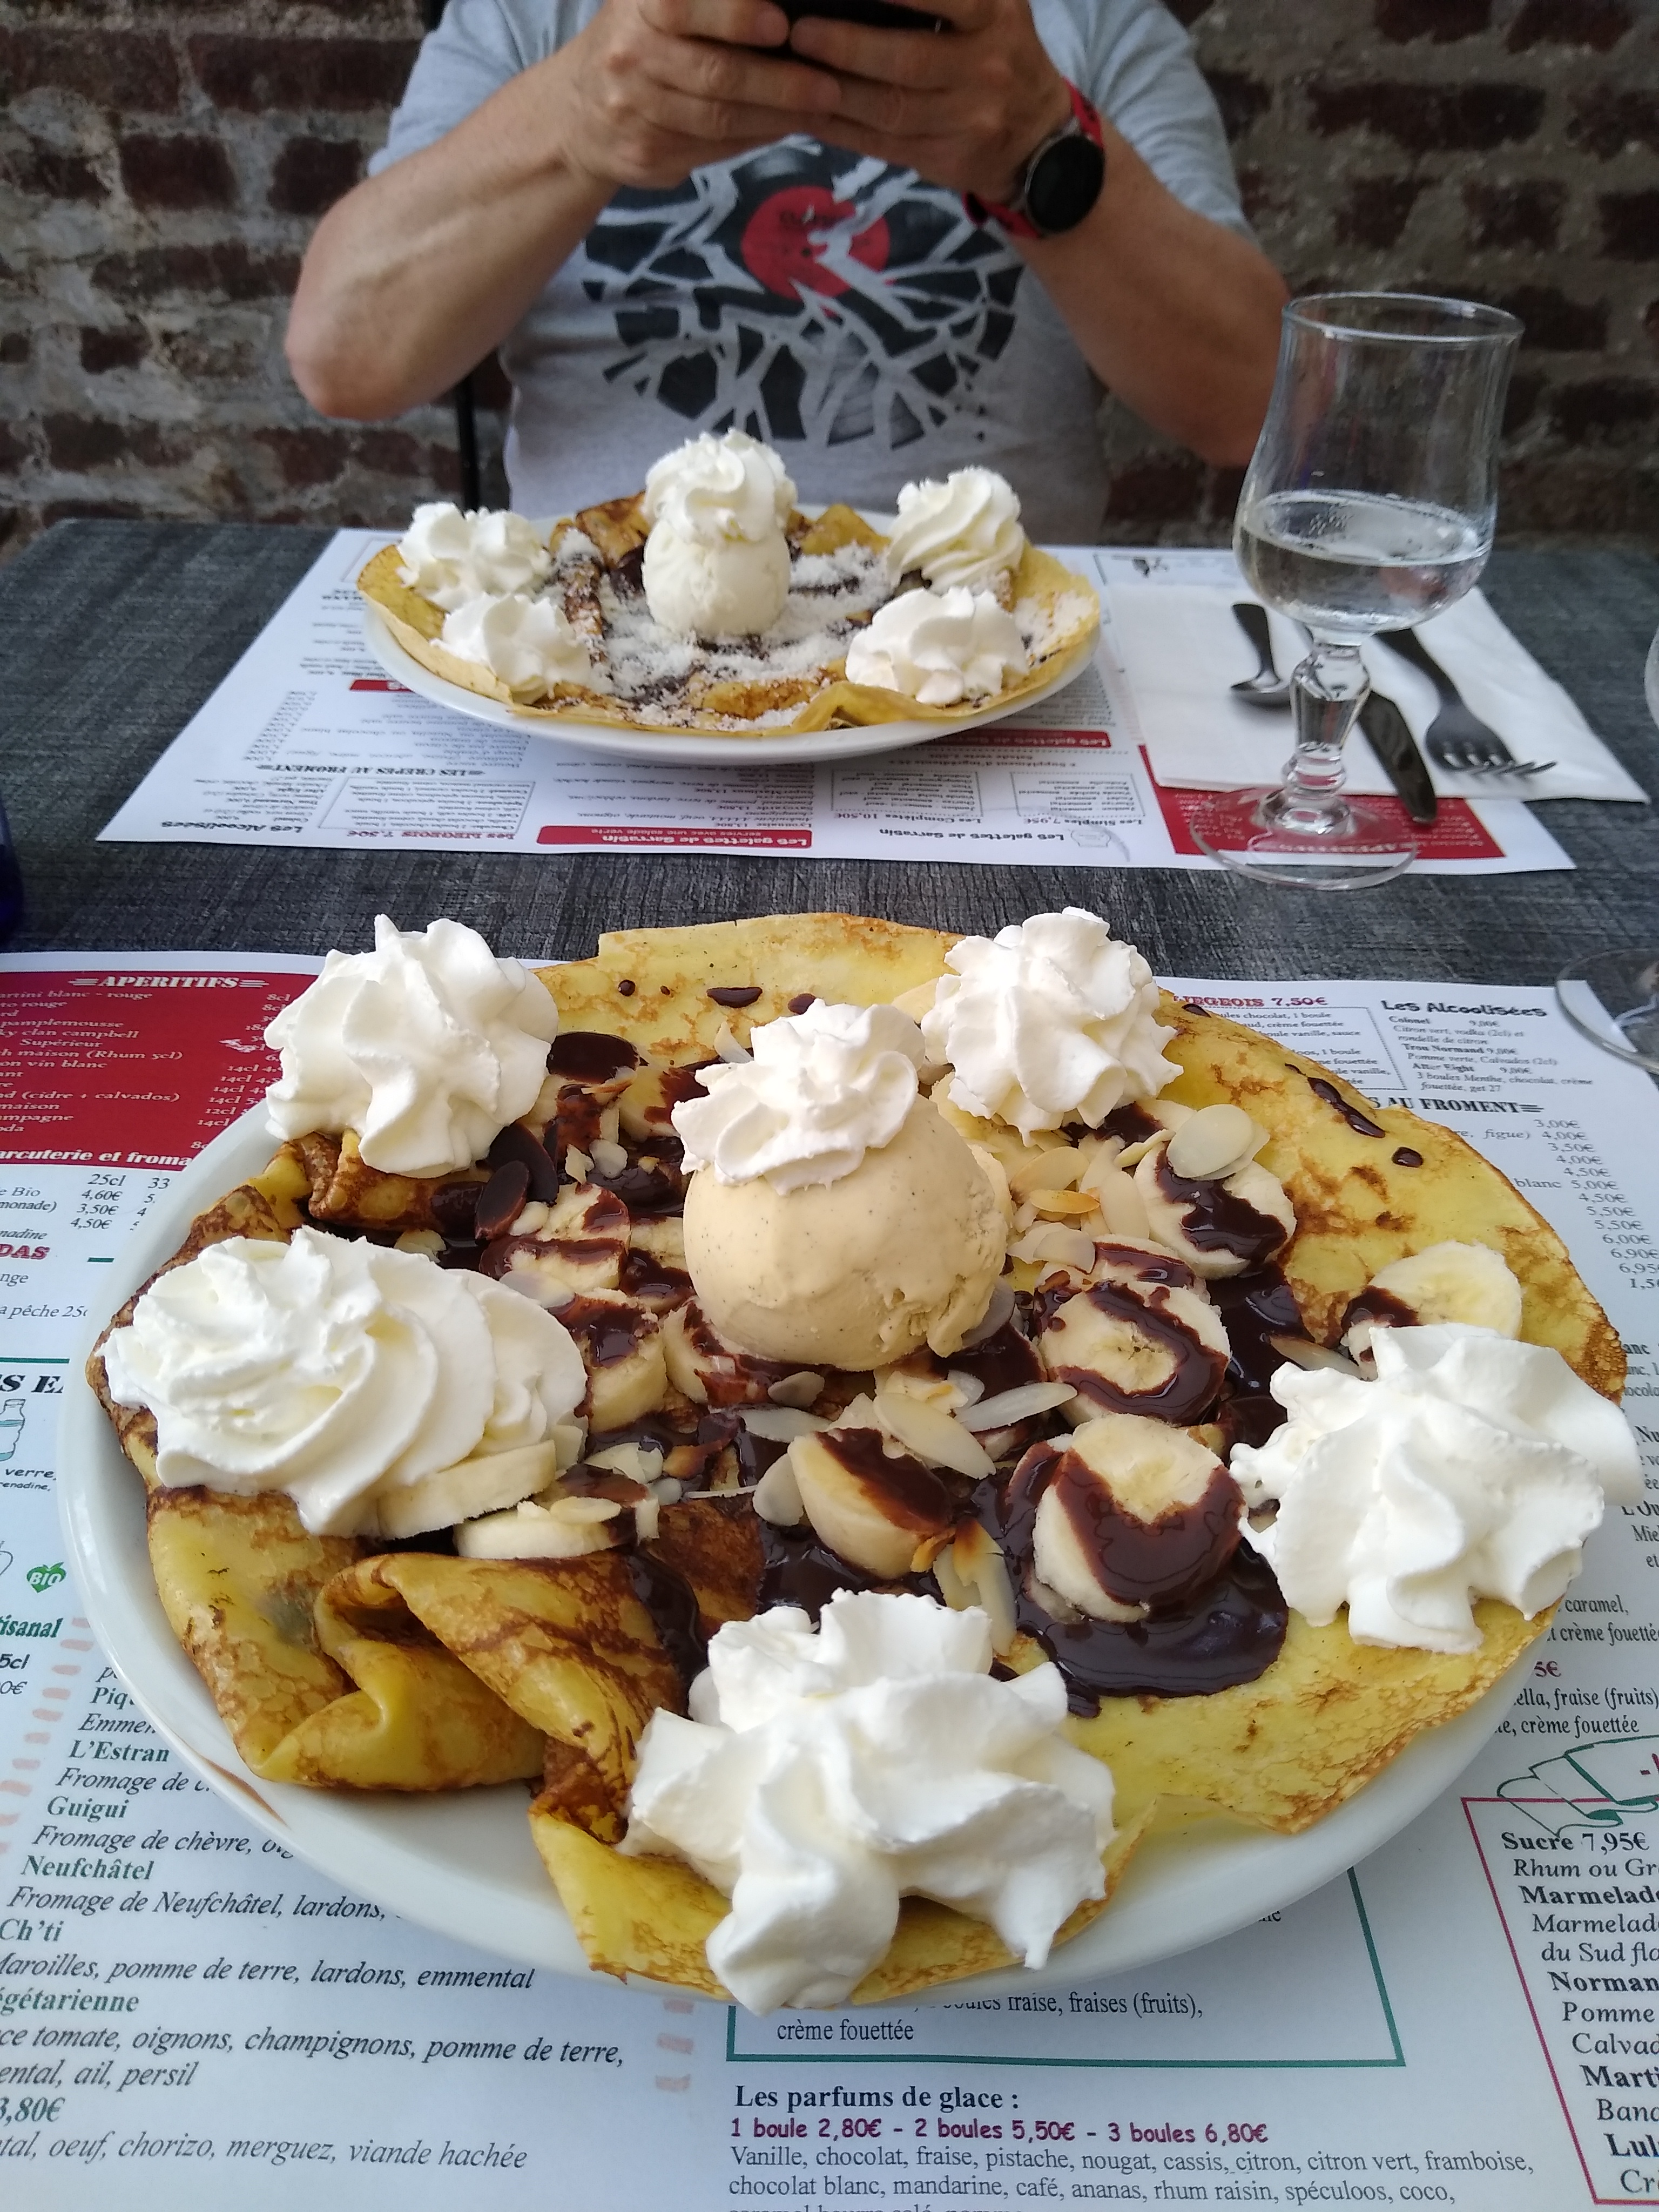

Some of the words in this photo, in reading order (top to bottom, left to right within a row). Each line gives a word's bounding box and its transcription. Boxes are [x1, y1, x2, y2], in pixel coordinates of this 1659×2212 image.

[602, 835, 675, 843] Sarrasin
[703, 837, 773, 845] galettes
[879, 829, 944, 838] Sarrasin
[970, 832, 1033, 840] galettes
[97, 976, 240, 988] APERITIFS
[1271, 997, 1328, 1007] 7,50€
[1380, 1000, 1421, 1011] Les
[1426, 1002, 1547, 1017] Alcoolisées
[19, 1037, 103, 1048] Supérieur
[22, 1028, 57, 1036] clan
[62, 1029, 139, 1040] campbell
[17, 1049, 79, 1057] maison
[85, 1050, 146, 1059] (Rhum
[60, 1060, 107, 1068] blanc
[21, 1091, 73, 1100] (cidre
[95, 1091, 180, 1102] calvados)
[1418, 1098, 1519, 1113] FROMENT
[1483, 1129, 1530, 1140] figue)
[98, 1151, 122, 1162] et
[87, 1174, 126, 1186] 25cl
[1513, 1178, 1561, 1189] blanc
[11, 1186, 41, 1197] Bio
[81, 1189, 123, 1201] 4,60€
[77, 1203, 119, 1216] 3,50€
[70, 1217, 112, 1230] 4,50€
[7, 1304, 59, 1320] pêche
[5, 1468, 57, 1481] verre,
[30, 1573, 61, 1586] BIO
[1564, 1594, 1629, 1615] caramel,
[1560, 1622, 1604, 1642] crème
[1554, 1688, 1601, 1711] fraise
[1521, 1715, 1570, 1734] crème
[1574, 1715, 1640, 1738] fouettée
[55, 1767, 157, 1795] Fromage
[161, 1771, 189, 1791] de
[47, 1796, 129, 1823] Guigui
[31, 1825, 136, 1854] Fromage
[140, 1829, 169, 1850] de
[174, 1831, 252, 1855] chèvre,
[1501, 1831, 1574, 1851] Sucre
[1582, 1832, 1650, 1855] 7,95€
[20, 1854, 154, 1880] Neufchâtel
[1513, 1858, 1581, 1878] Rhum
[1588, 1864, 1617, 1877] ou
[6, 1886, 114, 1917] Fromage
[119, 1890, 149, 1912] de
[152, 1891, 284, 1919] Neufchâtel,
[292, 1894, 385, 1921] lardons,
[1541, 1941, 1571, 1962] du
[1579, 1942, 1626, 1962] Sud
[104, 1963, 198, 1984] pomme
[203, 1957, 233, 1980] de
[238, 1961, 299, 1984] terre,
[310, 1959, 406, 1988] lardons,
[417, 1968, 535, 1989] emmental
[1068, 1991, 1128, 2013] fraises
[1133, 1992, 1203, 2019] (fruits),
[1562, 2001, 1655, 2023] Pomme
[777, 2019, 833, 2040] crème
[839, 2018, 914, 2040] fouettée
[32, 2026, 120, 2052] tomate,
[132, 2026, 233, 2055] oignons,
[245, 2026, 415, 2060] champignons,
[421, 2041, 516, 2063] pomme
[523, 2037, 553, 2061] de
[559, 2041, 623, 2067] terre,
[73, 2059, 114, 2089] ail,
[116, 2061, 199, 2093] persil
[734, 2085, 778, 2107] Les
[786, 2086, 894, 2114] parfums
[902, 2085, 932, 2107] de
[939, 2086, 1003, 2114] glace
[731, 2117, 741, 2137] 1
[753, 2117, 808, 2139] boule
[818, 2117, 882, 2142] 2,80€
[915, 2117, 927, 2137] 2
[938, 2117, 1003, 2139] boules
[1012, 2120, 1075, 2144] 5,50€
[1108, 2122, 1121, 2142] 3
[1129, 2122, 1196, 2143] boules
[1205, 2123, 1269, 2147] 6,80€
[49, 2130, 116, 2164] oeuf,
[118, 2131, 215, 2158] chorizo,
[225, 2140, 335, 2166] merguez,
[349, 2139, 432, 2165] viande
[438, 2140, 528, 2169] hachée
[730, 2146, 808, 2169] Vanille,
[815, 2146, 909, 2169] chocolat,
[916, 2145, 979, 2169] fraise,
[985, 2147, 1075, 2173] pistache,
[1082, 2153, 1157, 2175] nougat,
[1163, 2151, 1229, 2175] cassis,
[1236, 2151, 1301, 2174] citron,
[1307, 2150, 1368, 2170] citron
[1372, 2153, 1419, 2174] vert,
[1424, 2150, 1534, 2175] framboise,
[729, 2175, 817, 2195] chocolat
[824, 2175, 886, 2198] blanc,
[893, 2175, 1009, 2200] mandarine,
[1016, 2177, 1064, 2201] café,
[1072, 2184, 1148, 2203] ananas,
[1153, 2180, 1209, 2200] rhum
[1214, 2180, 1279, 2204] raisin,
[1285, 2180, 1393, 2206] spéculoos,
[1399, 2186, 1455, 2204] coco,
